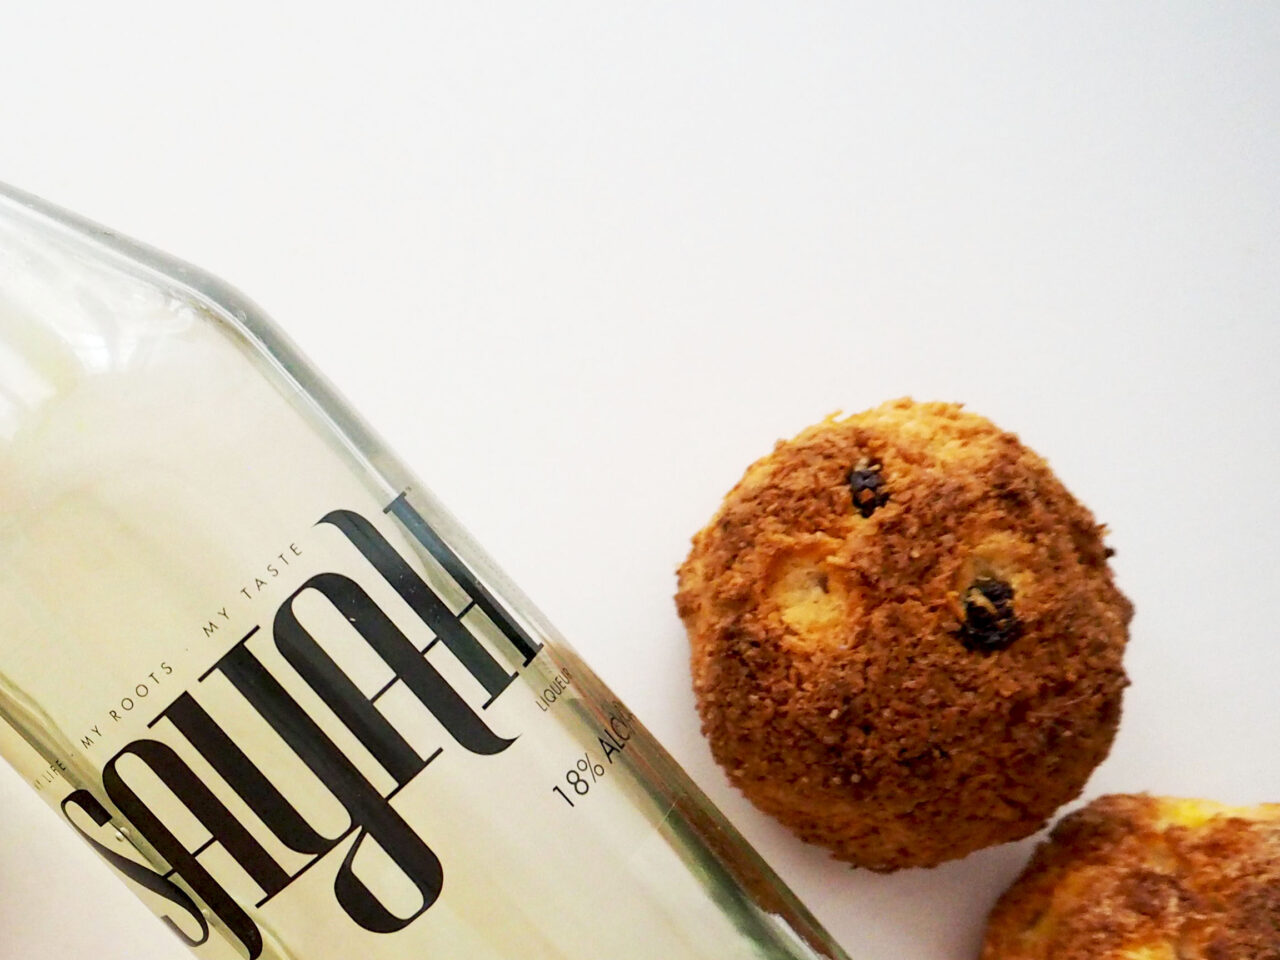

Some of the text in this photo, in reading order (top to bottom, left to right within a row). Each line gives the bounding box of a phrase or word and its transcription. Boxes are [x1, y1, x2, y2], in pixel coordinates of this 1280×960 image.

[80, 725, 102, 749] MY
[108, 662, 173, 722] ROOTS
[202, 607, 230, 637] MY
[240, 543, 302, 599] TASTE
[535, 667, 573, 712] LIQUEUR
[552, 752, 605, 807] 18%
